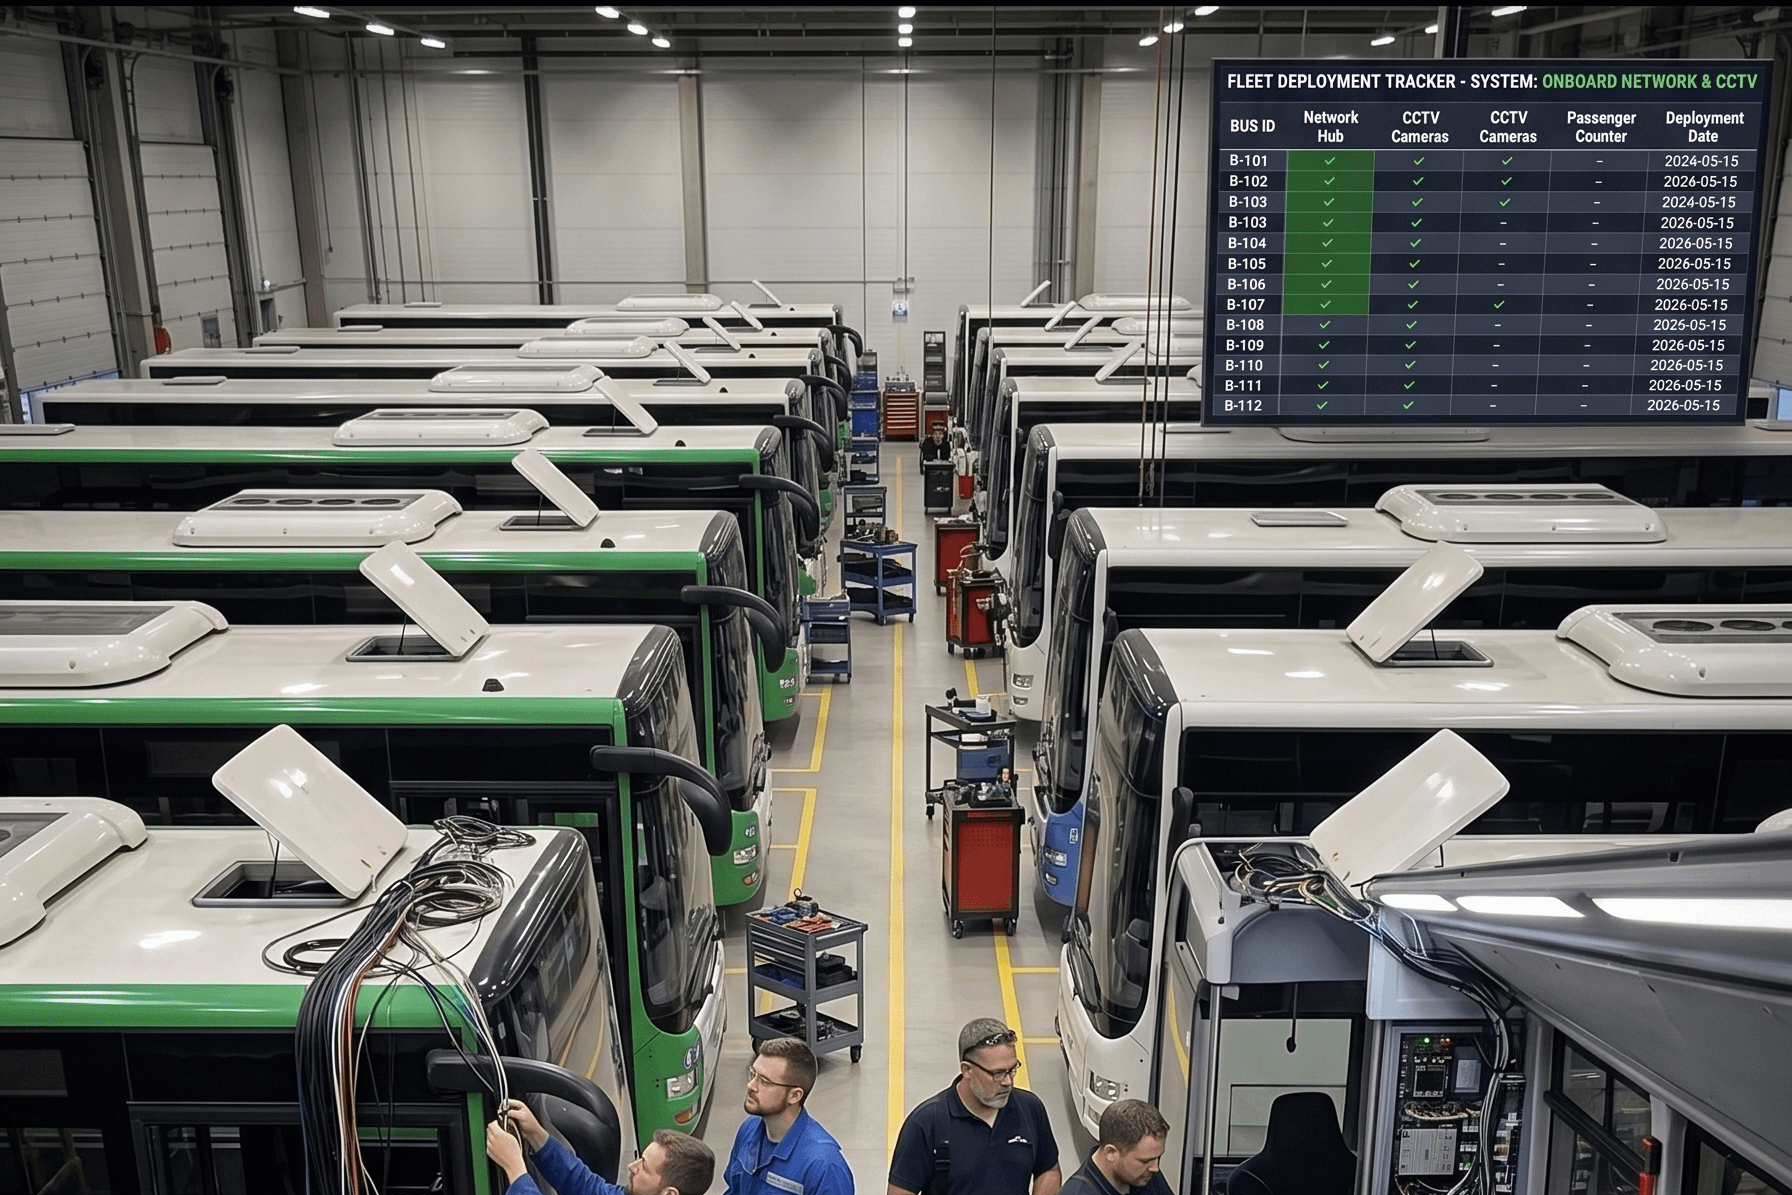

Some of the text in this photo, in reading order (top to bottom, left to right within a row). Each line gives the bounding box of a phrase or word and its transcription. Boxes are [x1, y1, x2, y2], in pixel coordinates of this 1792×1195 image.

[1227, 73, 1274, 89] FLEET
[1277, 73, 1382, 89] DEPLOYMENT
[1384, 73, 1456, 89] TRACKER
[1470, 73, 1538, 89] SYSTEM:
[1542, 73, 1617, 89] ONBOARD
[1621, 73, 1698, 89] NETWORK
[1701, 73, 1712, 89] &
[1715, 73, 1758, 89] CCTV
[1303, 109, 1359, 124] Network
[1402, 110, 1441, 125] CCTV
[1490, 110, 1529, 125] CCTV
[1567, 110, 1637, 128] Passenger
[1665, 110, 1745, 129] Deployment
[1230, 118, 1276, 133] BUS ID
[1317, 128, 1345, 143] Hub
[1391, 129, 1450, 144] Cameras
[1479, 129, 1538, 143] Cameras
[1575, 128, 1628, 143] Counter
[1688, 128, 1719, 143] Date
[1229, 153, 1267, 167] B-101
[1229, 174, 1268, 188] B-102
[1663, 175, 1738, 188] 2026-05-15
[1229, 195, 1268, 208] B-103
[1228, 215, 1267, 229] B-103
[1660, 216, 1735, 230] 2026-05-15
[1228, 236, 1267, 250] B-104
[1659, 236, 1733, 250] 2026-05-15
[1228, 257, 1267, 270] B-105
[1657, 257, 1732, 270] 2026-05-15
[1227, 277, 1266, 291] B-106
[1656, 277, 1730, 291] 2026-05-15
[1226, 298, 1266, 311] B-107
[1654, 298, 1729, 311] 2026-05-15
[1226, 318, 1265, 331] B-108
[1226, 339, 1265, 352] B-109
[1651, 339, 1725, 352] 2026-05-15
[1225, 359, 1264, 372] B-110
[1650, 358, 1724, 372] 2026-05-15
[1225, 379, 1261, 392] B-111
[1648, 379, 1722, 392] 2026-05-15
[1224, 399, 1263, 412] B-112
[1646, 399, 1721, 412] 2026-05-15
